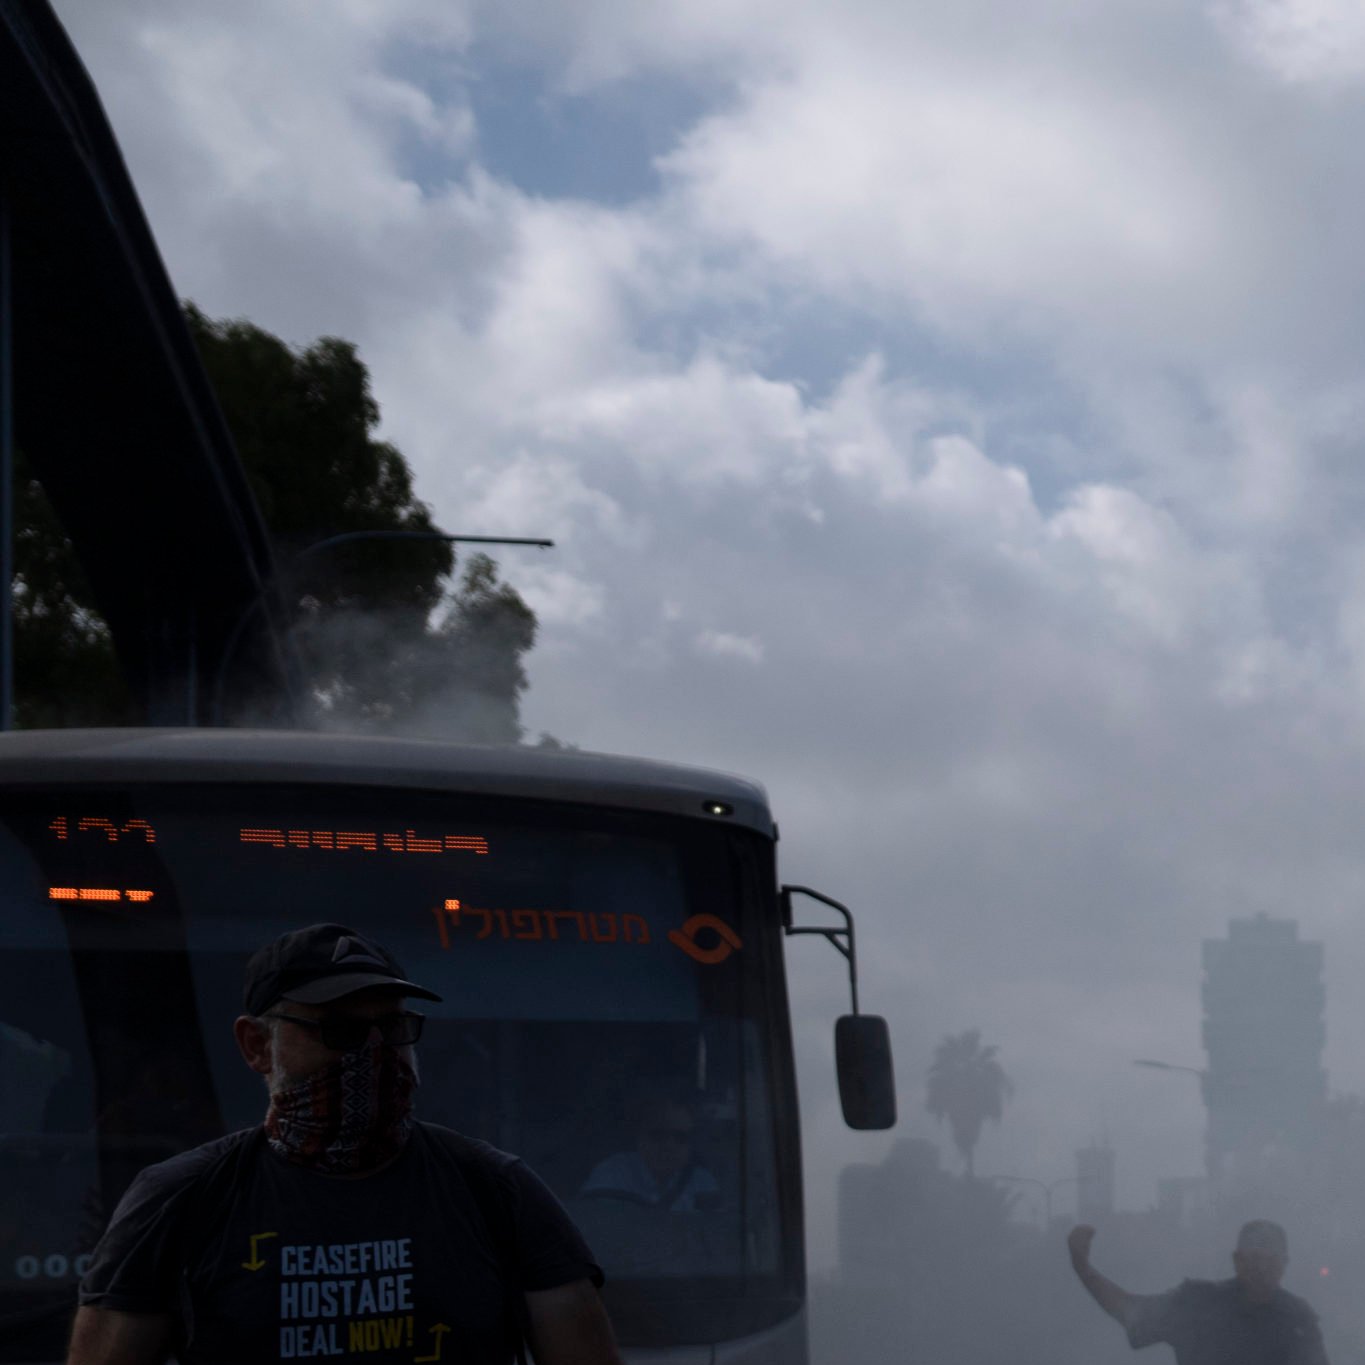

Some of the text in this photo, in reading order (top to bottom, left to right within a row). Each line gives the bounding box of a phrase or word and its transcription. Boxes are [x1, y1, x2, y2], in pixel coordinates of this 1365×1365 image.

[431, 902, 651, 950] מטרופולין
[280, 1238, 414, 1276] CEASEFIRE
[280, 1273, 415, 1320] HOSTAGE
[279, 1315, 415, 1359] DEAL NOW!
